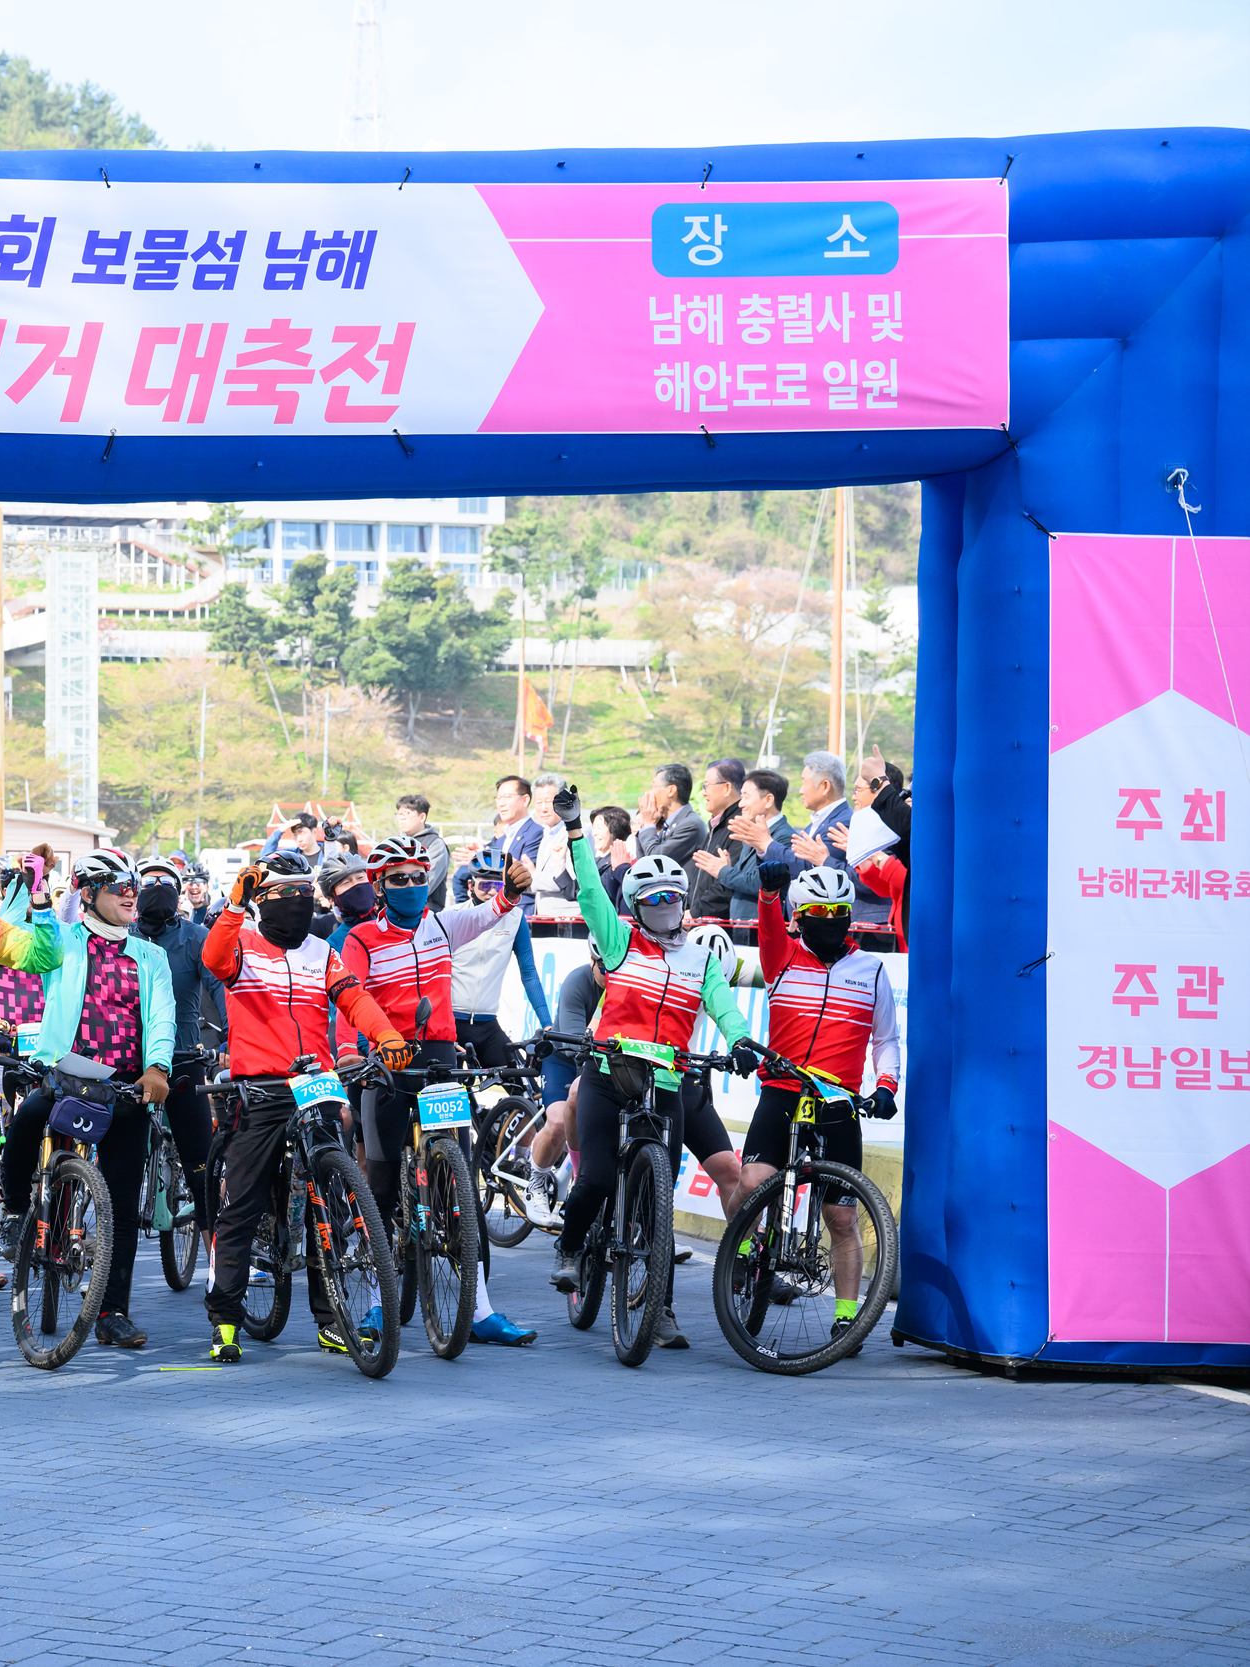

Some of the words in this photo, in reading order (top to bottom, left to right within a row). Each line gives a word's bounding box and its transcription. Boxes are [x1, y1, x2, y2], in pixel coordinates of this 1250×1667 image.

[71, 229, 247, 291] 보물섬
[261, 229, 378, 291] 남해
[680, 213, 728, 266] 장
[823, 213, 871, 258] 소
[649, 293, 724, 345] 남해
[736, 291, 856, 345] 충렬사
[867, 290, 905, 342] 및
[124, 317, 417, 424] 대축전
[652, 360, 811, 413] 해안도로
[822, 358, 899, 410] 일원
[1116, 788, 1163, 841] 주
[1180, 787, 1226, 842] 최
[1111, 963, 1159, 1017] 주
[1176, 965, 1225, 1020] 관
[301, 1081, 340, 1097] 70047
[1077, 1045, 1250, 1092] 경남일보
[425, 1100, 464, 1115] 70052
